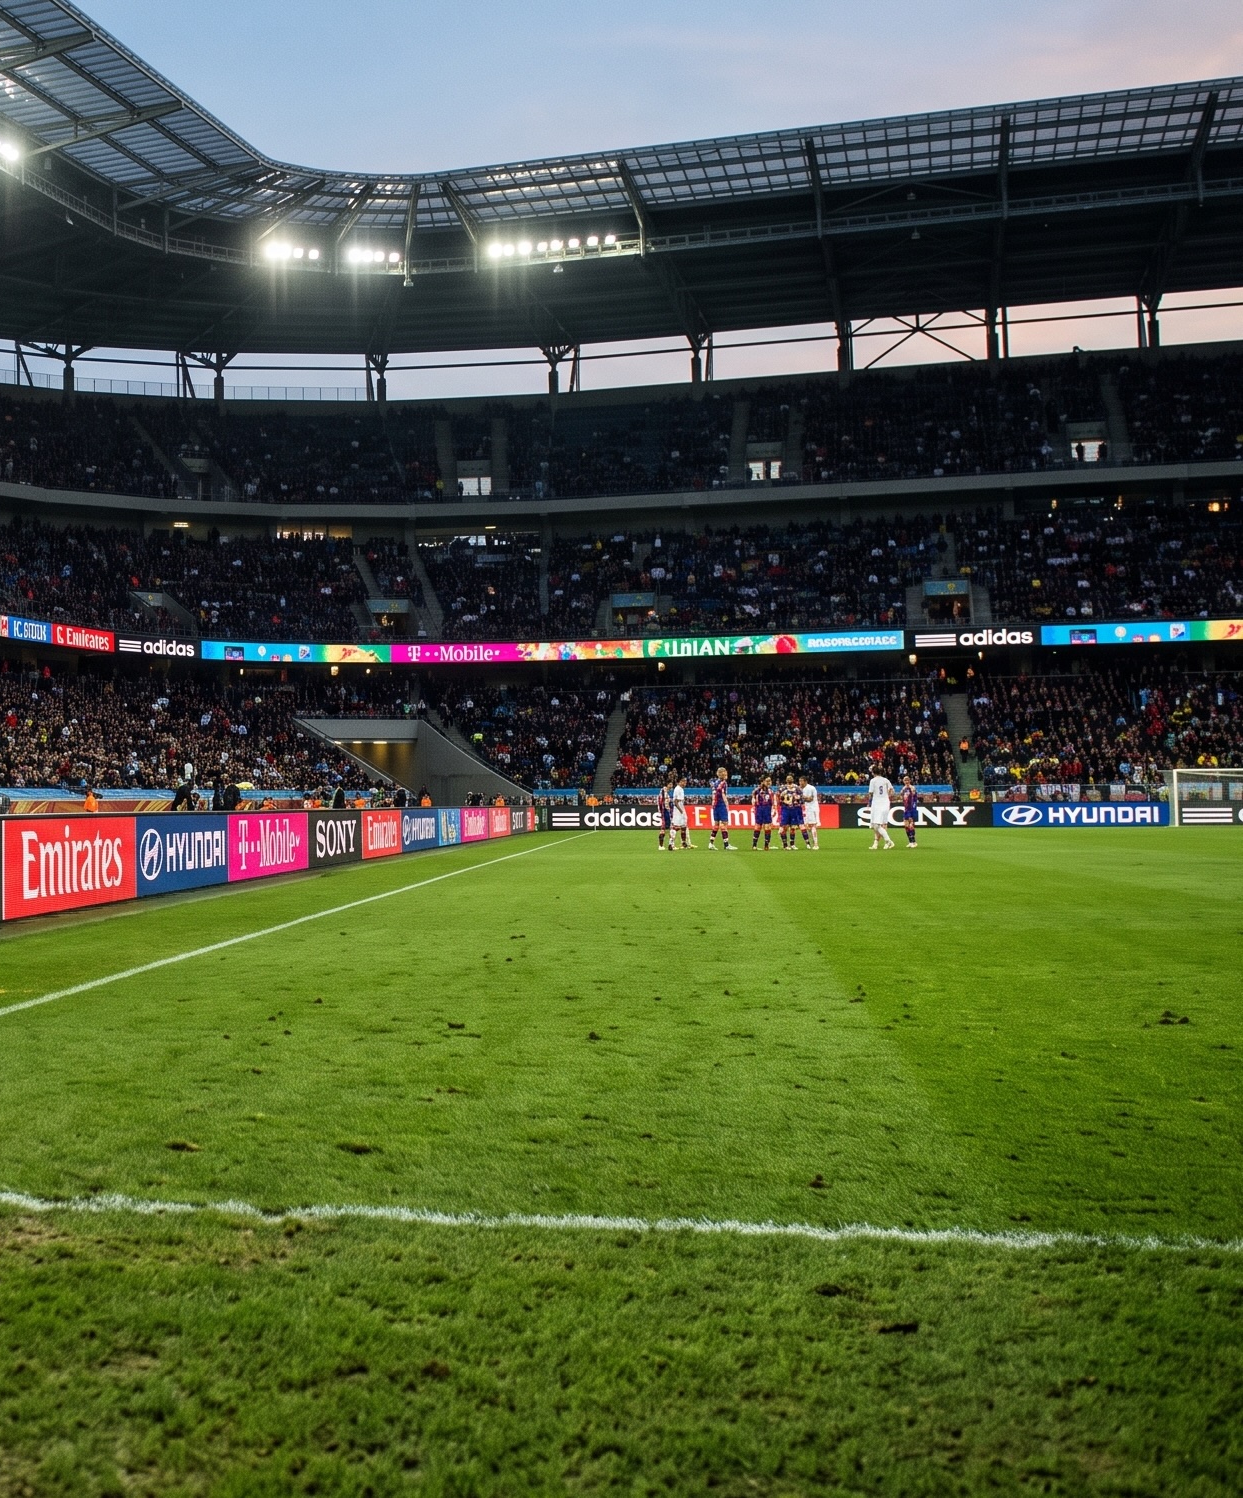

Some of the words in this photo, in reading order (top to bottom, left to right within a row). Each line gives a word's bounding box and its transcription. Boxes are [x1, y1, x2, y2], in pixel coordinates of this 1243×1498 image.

[959, 628, 1034, 646] adidas
[143, 639, 195, 657] adidas
[584, 807, 662, 827] adidas
[1048, 806, 1160, 824] HYUNDAI
[316, 819, 357, 859] SONY
[166, 830, 226, 873] HYUNDAI
[21, 824, 123, 901] Emirates
